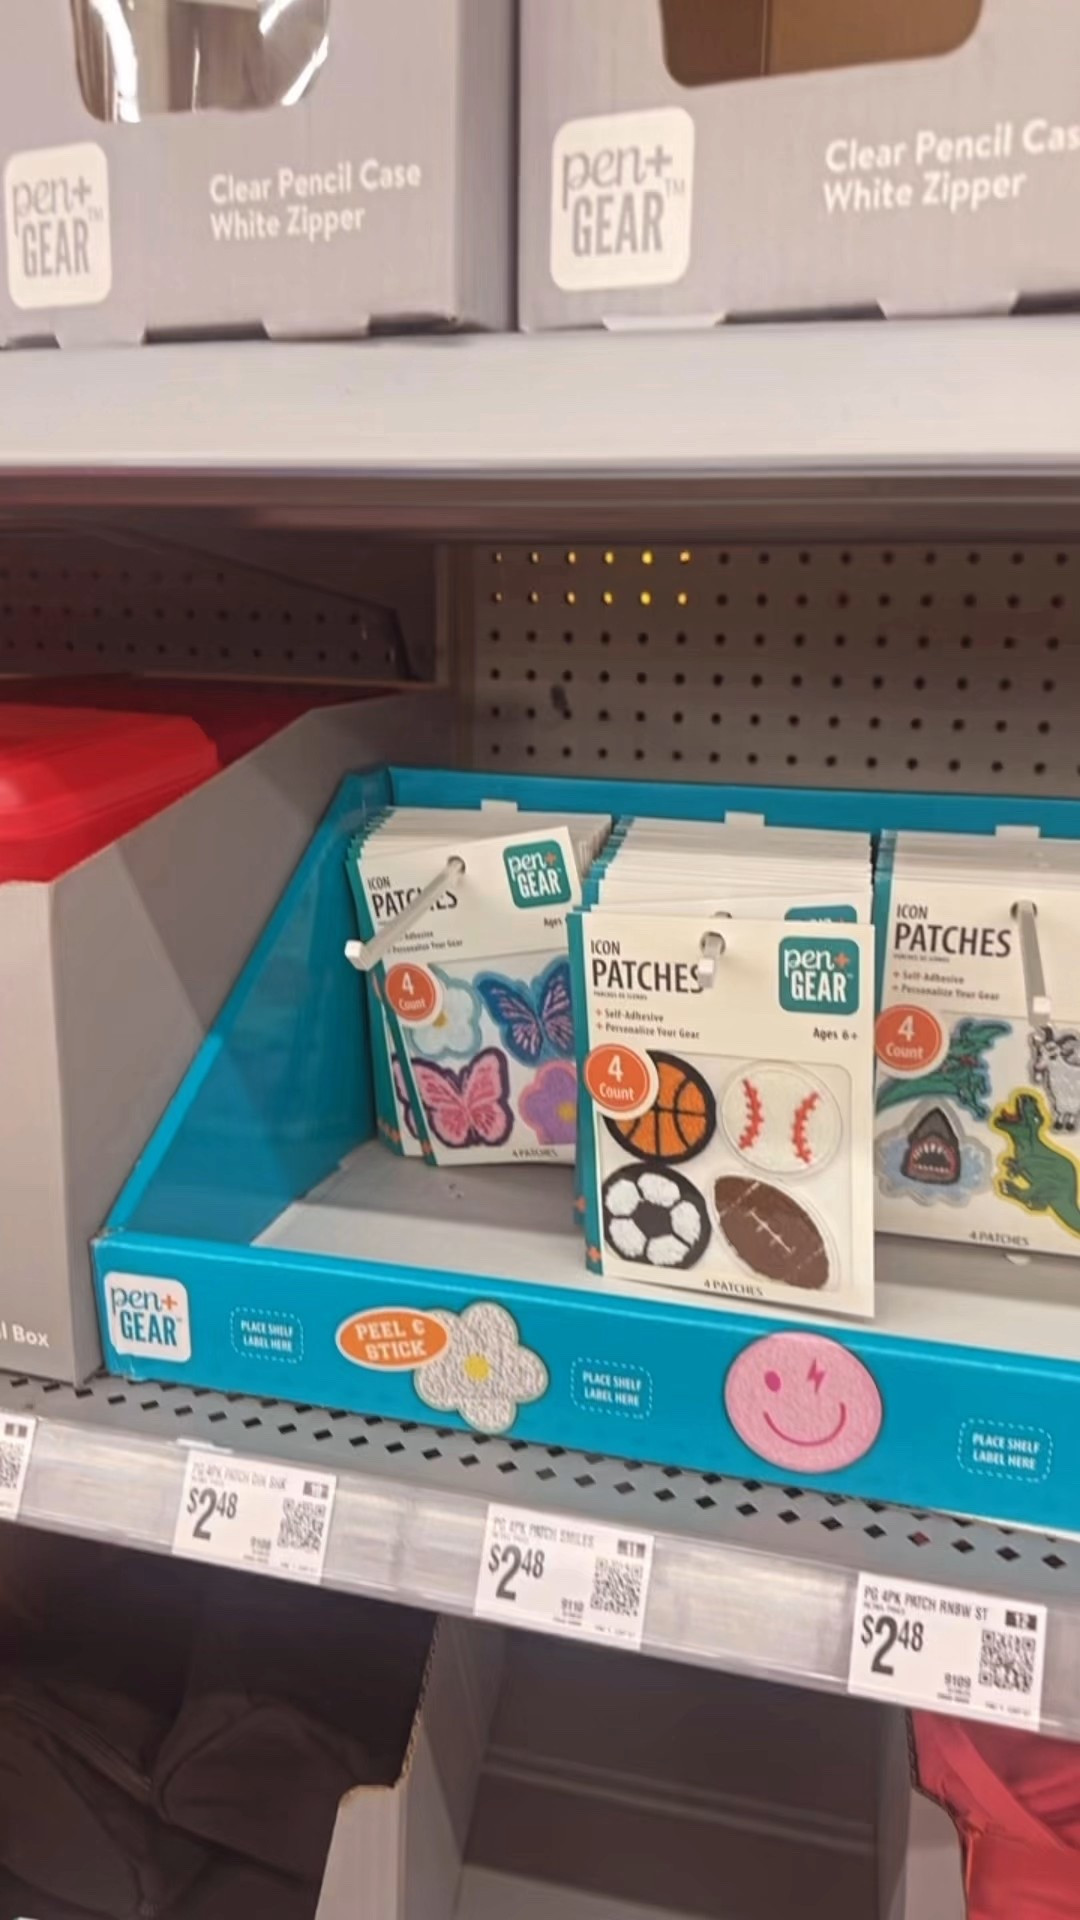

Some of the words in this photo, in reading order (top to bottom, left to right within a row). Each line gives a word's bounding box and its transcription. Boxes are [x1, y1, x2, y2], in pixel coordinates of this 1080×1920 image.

[826, 138, 904, 172] Clear
[916, 122, 1011, 163] Pencil
[210, 174, 271, 205] Clear
[278, 163, 351, 198] Pencil
[359, 160, 421, 190] Case
[823, 181, 911, 214] White
[922, 171, 1026, 214] Zipper
[210, 210, 280, 241] White
[287, 206, 364, 243] Zipper
[572, 190, 663, 257] GEAR
[21, 220, 90, 278] GEAR
[367, 876, 391, 890] ICON
[518, 868, 561, 898] GEAR
[896, 904, 928, 920] ICON
[590, 939, 621, 956] ICON
[894, 923, 1011, 958] PATCHES
[402, 971, 414, 996] 4
[592, 959, 704, 994] PATCHES
[791, 971, 848, 1003] GEAR
[903, 971, 964, 985] Self-Adhesive
[901, 984, 953, 998] Personalize
[956, 988, 975, 998] Your
[605, 1008, 664, 1022] Self-Adhesive
[606, 1023, 655, 1037] Personalize
[657, 1026, 676, 1038] Your
[679, 1028, 700, 1039] Gear
[813, 1027, 838, 1042] Ages
[898, 1015, 914, 1041] 4
[886, 1042, 924, 1061] Count
[608, 1055, 624, 1083] 4
[599, 1083, 635, 1101] Count
[712, 1280, 763, 1297] PATCHES
[12, 1323, 50, 1349] Box
[120, 1310, 177, 1347] GEAR
[241, 1320, 266, 1335] PLACE
[355, 1320, 407, 1341] PEEL
[365, 1340, 427, 1361] STICK
[583, 1370, 611, 1387] PLACE
[613, 1376, 641, 1392] SHELF
[585, 1386, 613, 1403] LABEL
[614, 1392, 639, 1408] HERE
[972, 1432, 1005, 1450] PLACE
[1007, 1438, 1041, 1454] SHELF
[973, 1448, 1006, 1466] LABEL
[1008, 1455, 1036, 1471] HERE
[864, 1586, 878, 1600] PG
[882, 1589, 901, 1605] 4PK
[905, 1592, 936, 1612] PATCH
[939, 1598, 971, 1618] RNBW
[975, 1606, 988, 1621] ST
